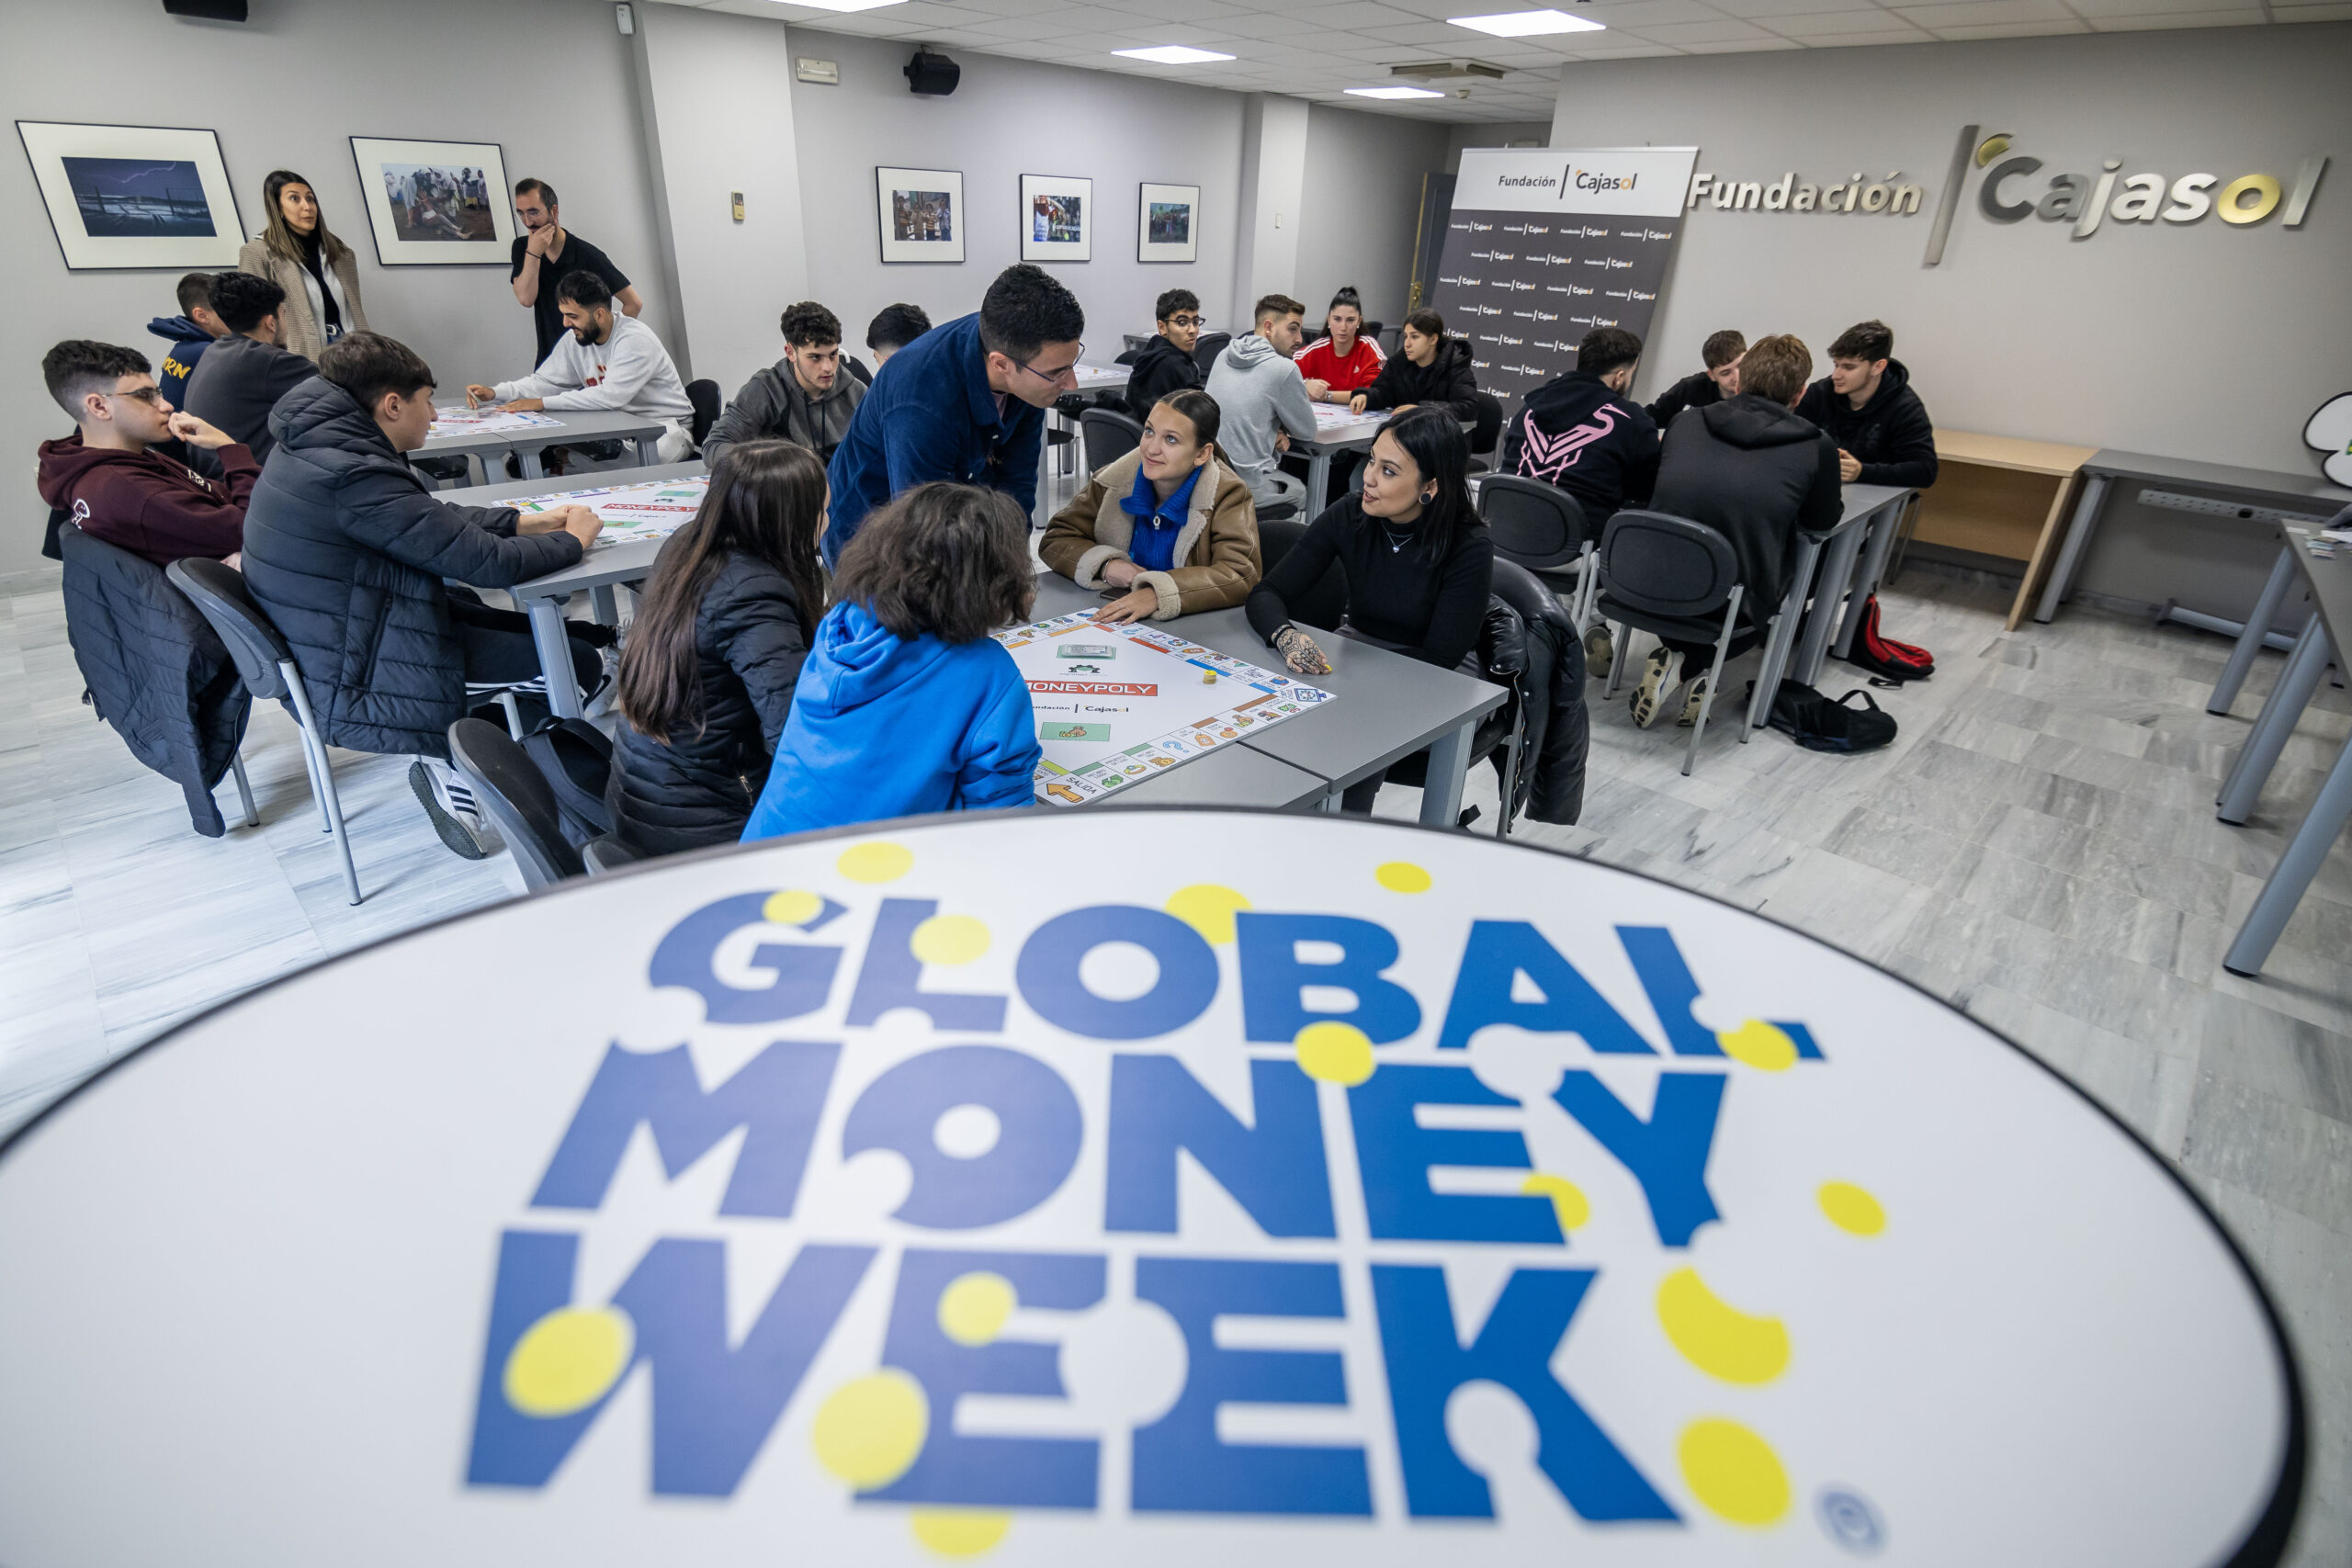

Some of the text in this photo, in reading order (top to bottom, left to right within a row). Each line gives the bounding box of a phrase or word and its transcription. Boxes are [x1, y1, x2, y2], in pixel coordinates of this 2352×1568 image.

[1498, 171, 1638, 195] Fundación Cajasol
[1686, 151, 2330, 241] Fundación Cajasol
[1084, 704, 1129, 713] Cajasol
[1067, 777, 1097, 795] SALIDA
[647, 889, 1827, 1066] GLOBAL
[527, 1038, 1731, 1251] MONEY
[464, 1229, 1686, 1525] WEEK
